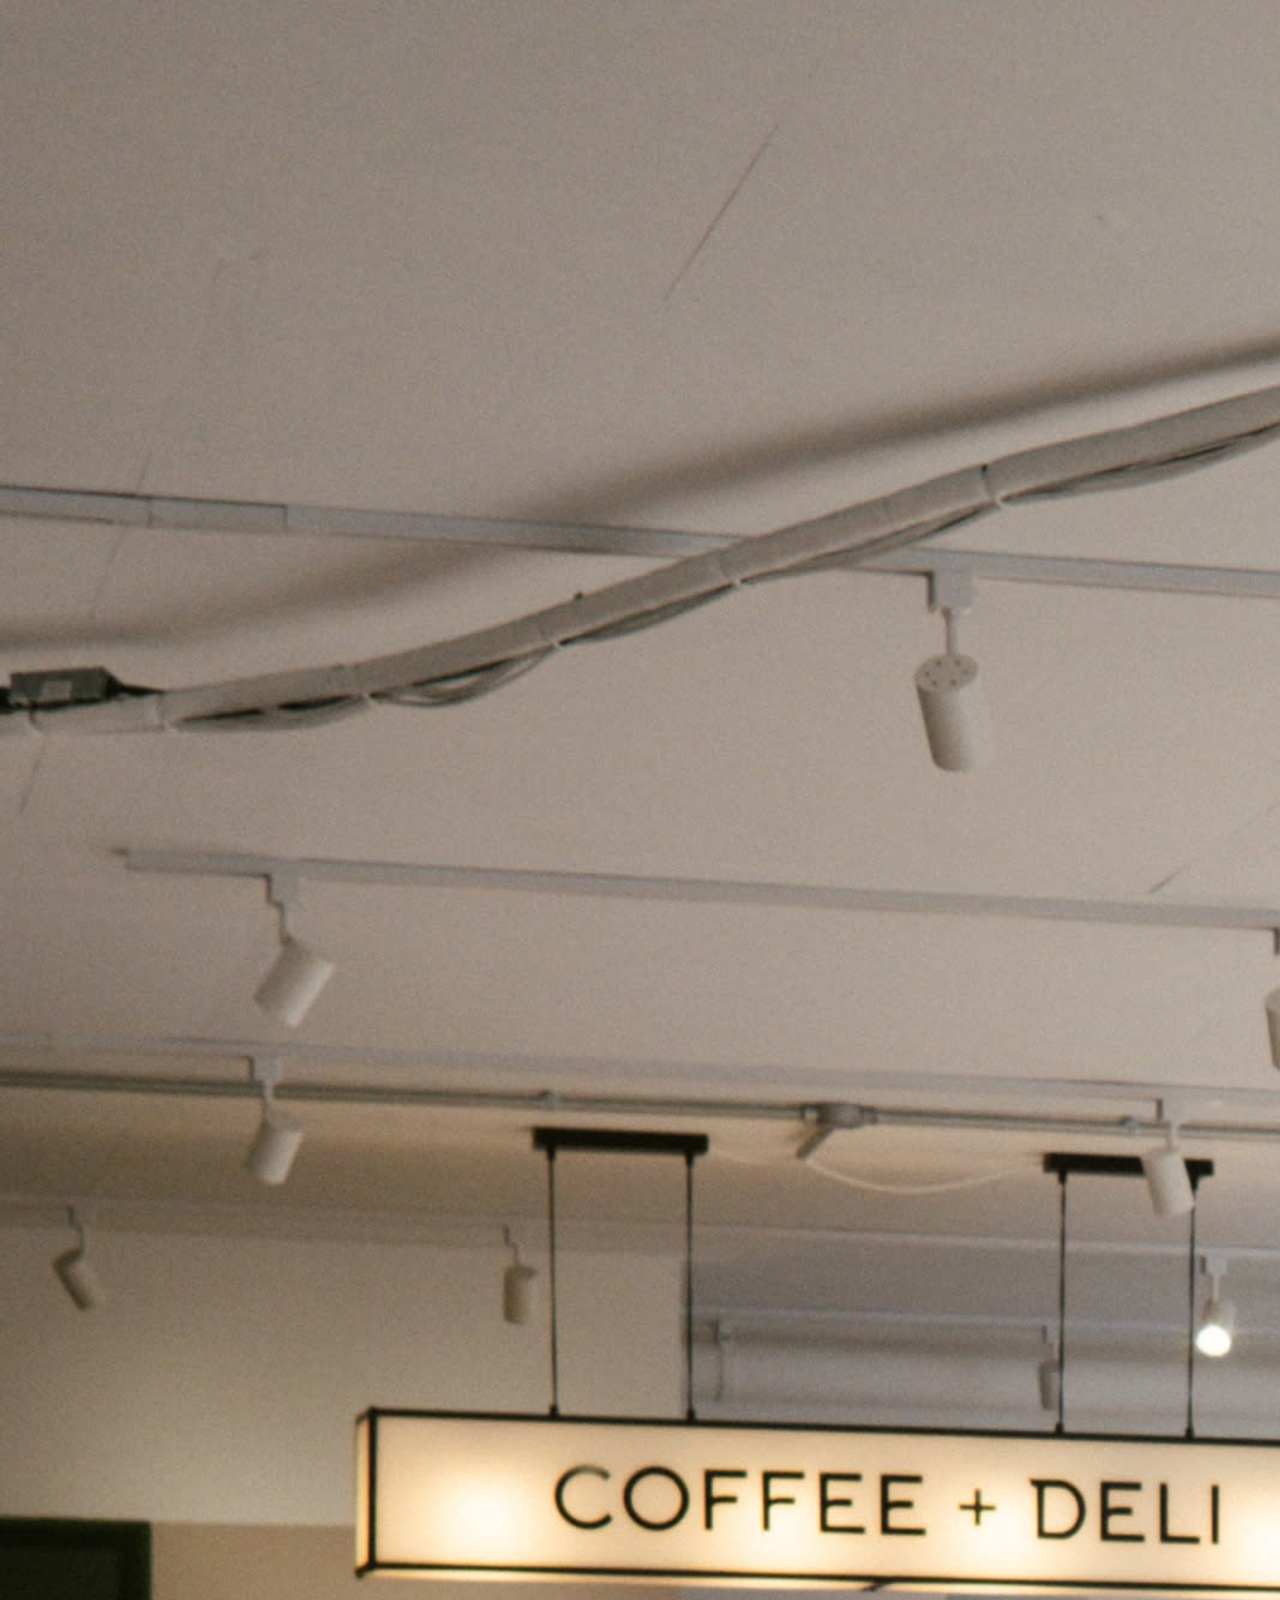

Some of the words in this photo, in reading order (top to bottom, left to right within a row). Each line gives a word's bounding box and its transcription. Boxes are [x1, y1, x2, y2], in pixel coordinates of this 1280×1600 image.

[554, 1465, 926, 1536] COFFEE
[959, 1489, 996, 1526] +
[1030, 1478, 1219, 1544] DELI
